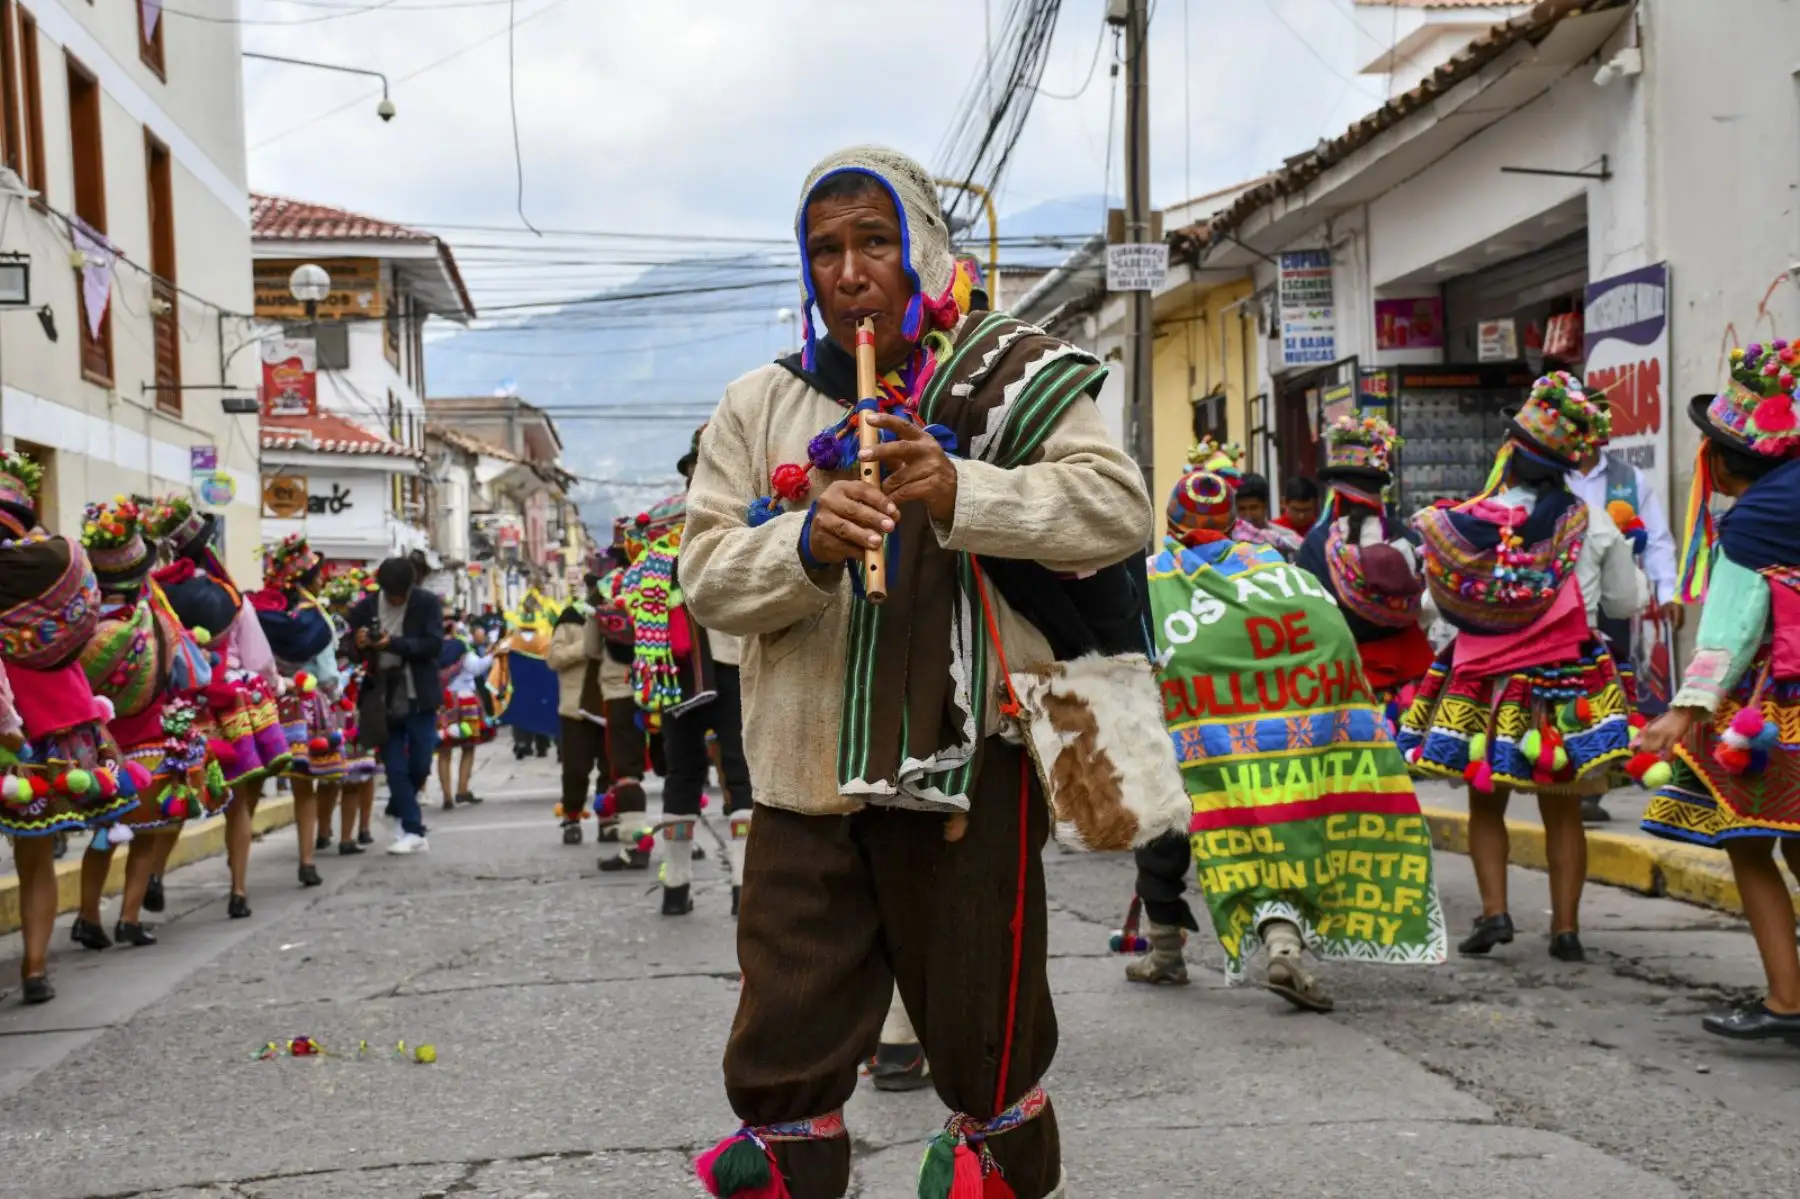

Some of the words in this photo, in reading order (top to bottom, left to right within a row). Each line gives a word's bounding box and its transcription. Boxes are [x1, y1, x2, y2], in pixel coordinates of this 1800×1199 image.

[307, 483, 353, 514] aro
[1245, 609, 1316, 660] DE
[1219, 749, 1381, 808] HUANTA
